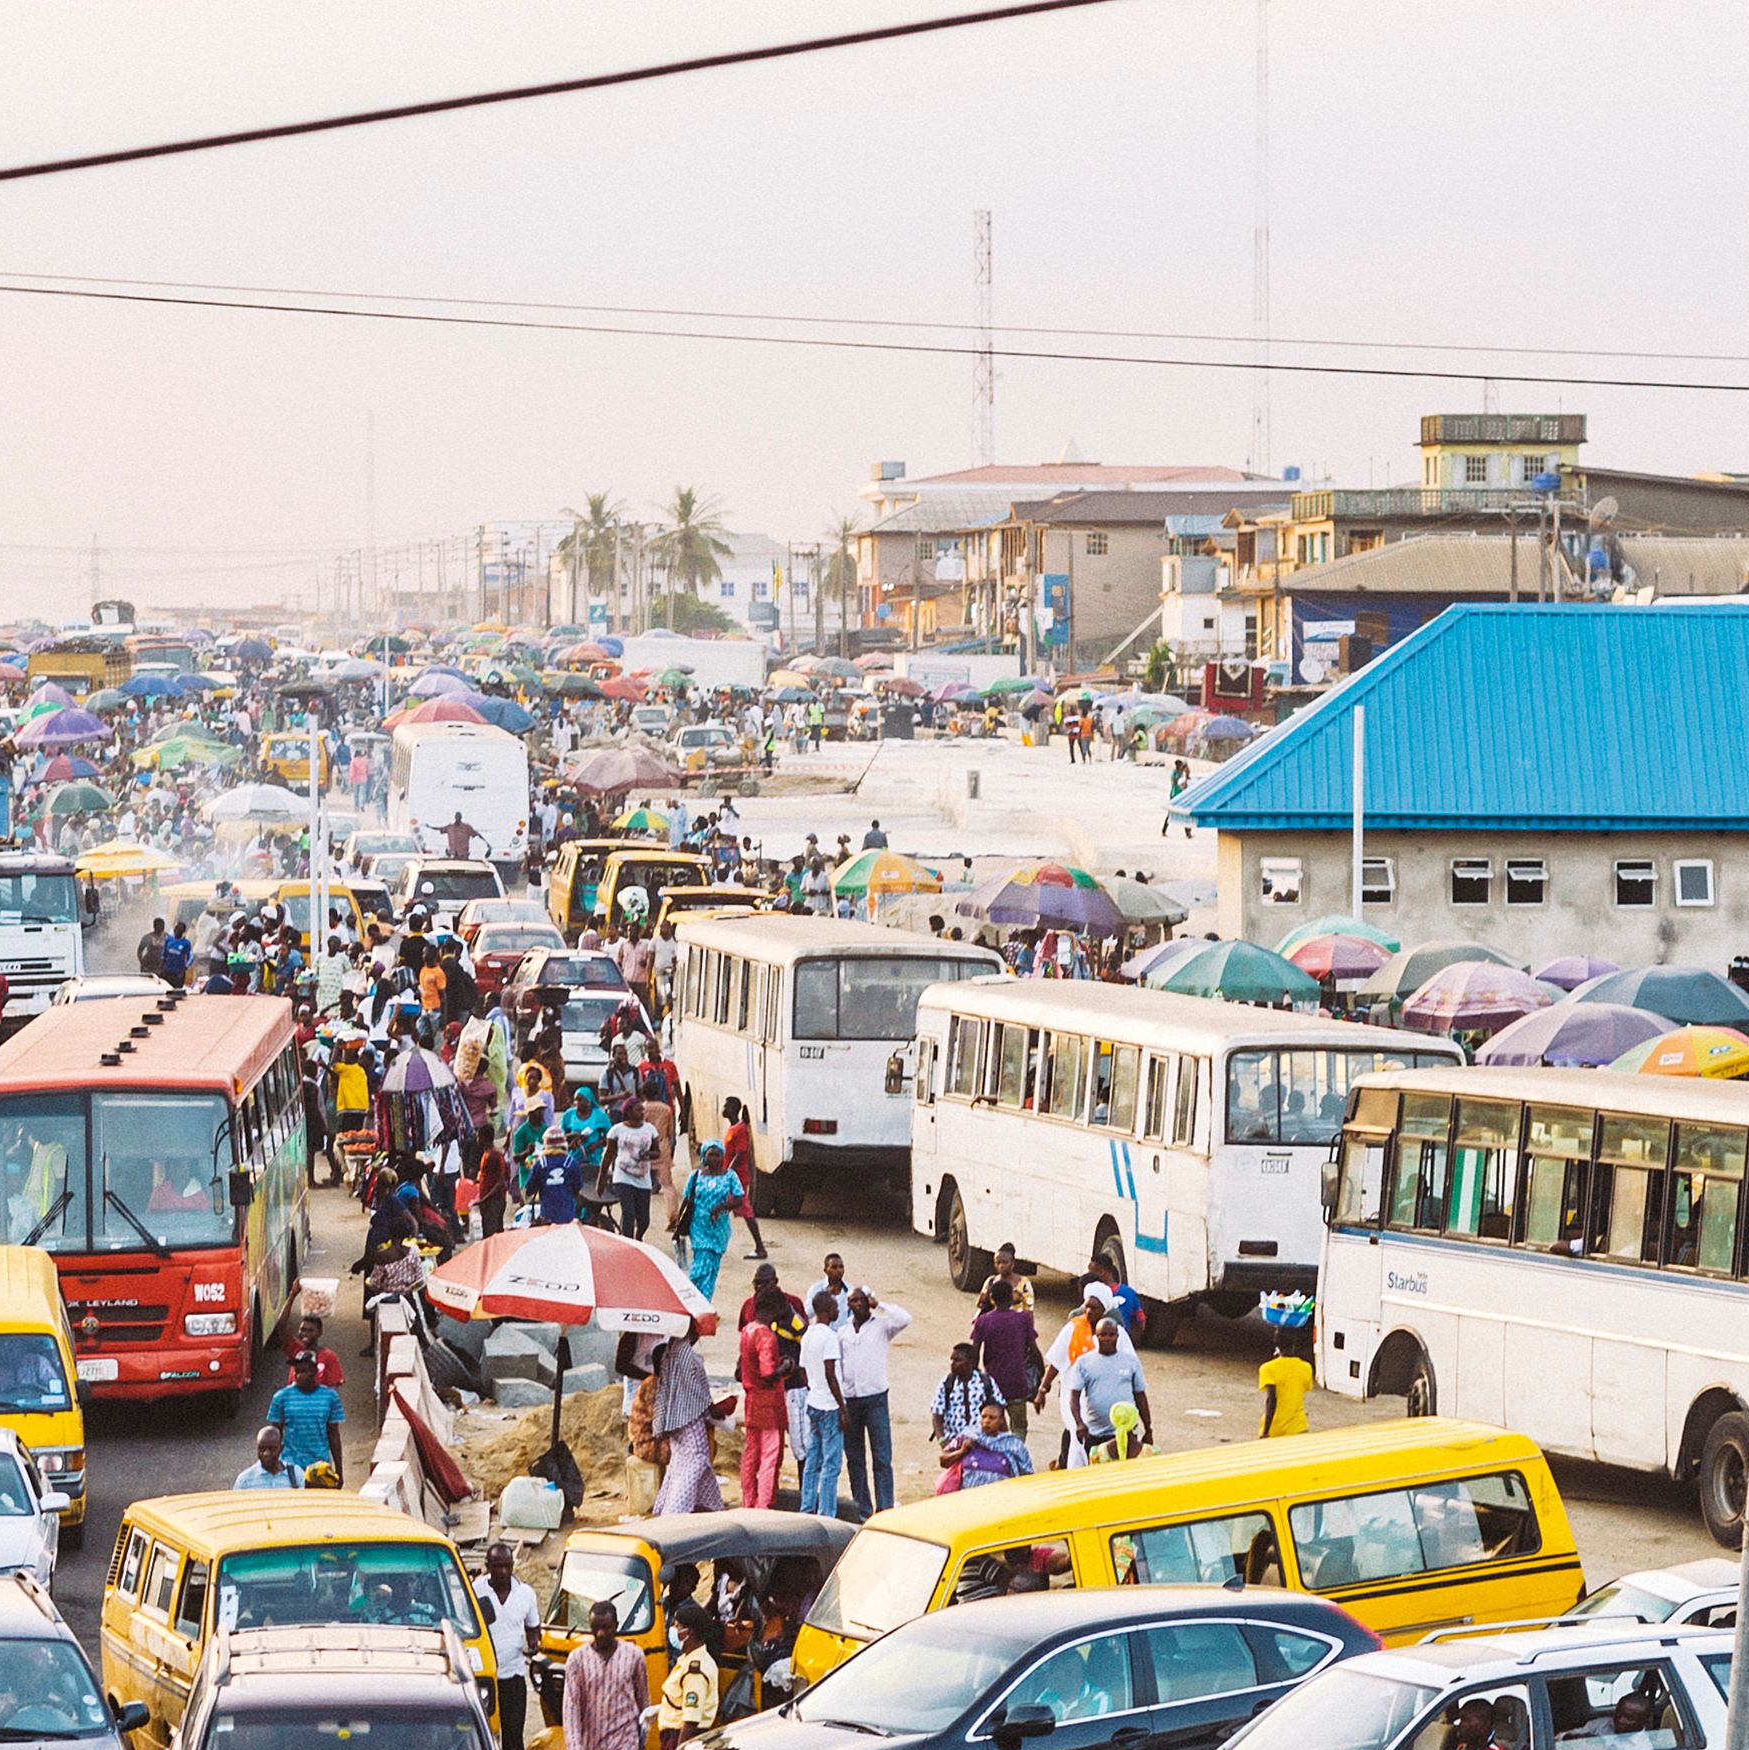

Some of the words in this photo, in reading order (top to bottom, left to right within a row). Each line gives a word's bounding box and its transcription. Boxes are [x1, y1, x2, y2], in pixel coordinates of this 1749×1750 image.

[1387, 1271, 1428, 1294] Starbus
[86, 1299, 138, 1307] LEYLAND
[622, 1313, 660, 1323] ZEDD
